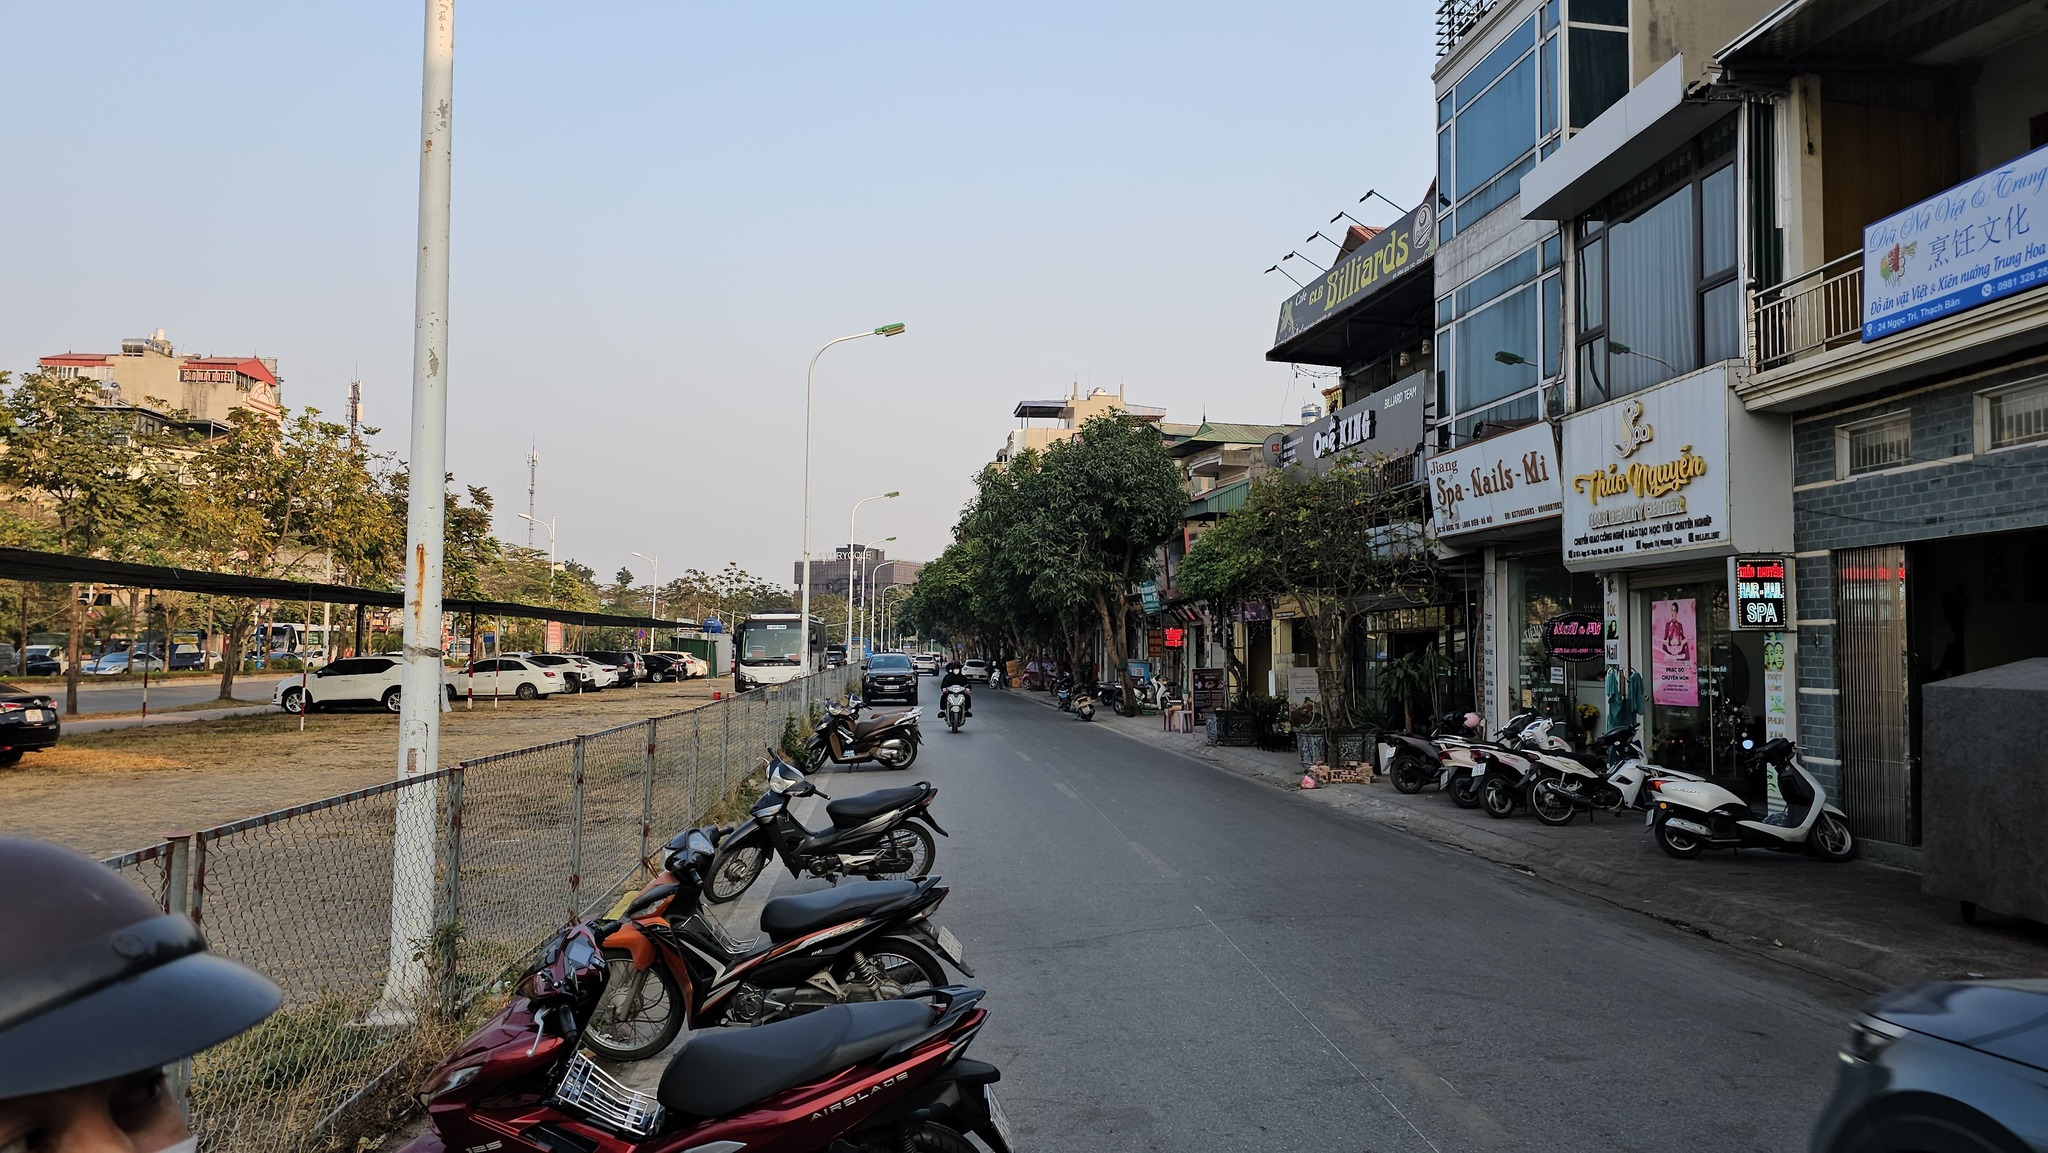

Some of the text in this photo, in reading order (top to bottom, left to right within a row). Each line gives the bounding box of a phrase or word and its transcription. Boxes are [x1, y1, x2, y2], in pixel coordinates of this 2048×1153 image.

[1928, 203, 2030, 271] 烹饪文化
[1295, 290, 1307, 307] Cafe
[1308, 284, 1324, 306] CLB
[1324, 229, 1409, 311] Billiards
[1870, 296, 1882, 315] Đồ
[1911, 283, 1929, 301] Việt
[1937, 273, 1958, 292] Xiên
[1993, 252, 2022, 272] Trung
[2024, 242, 2047, 262] Hoa
[1997, 266, 2048, 291] 0981 328 28
[1877, 322, 1887, 332] 24
[1887, 316, 1906, 329] Ngọc
[212, 371, 231, 381] HOTEL
[1384, 385, 1417, 410] BILLIARD TEAM
[1313, 431, 1338, 460] One
[1338, 409, 1375, 450] KING
[1614, 400, 1654, 459] Spa
[1430, 460, 1459, 475] Jiang
[1436, 477, 1465, 519] Spa
[1470, 459, 1514, 498] Nails
[1522, 450, 1550, 485] Mi
[1573, 464, 1628, 506] Thảo
[1589, 495, 1687, 529] HAIR BEAUTY CENTER
[1746, 602, 1778, 623] SPA
[1607, 644, 1617, 660] Nail
[465, 1140, 503, 1153] 125
